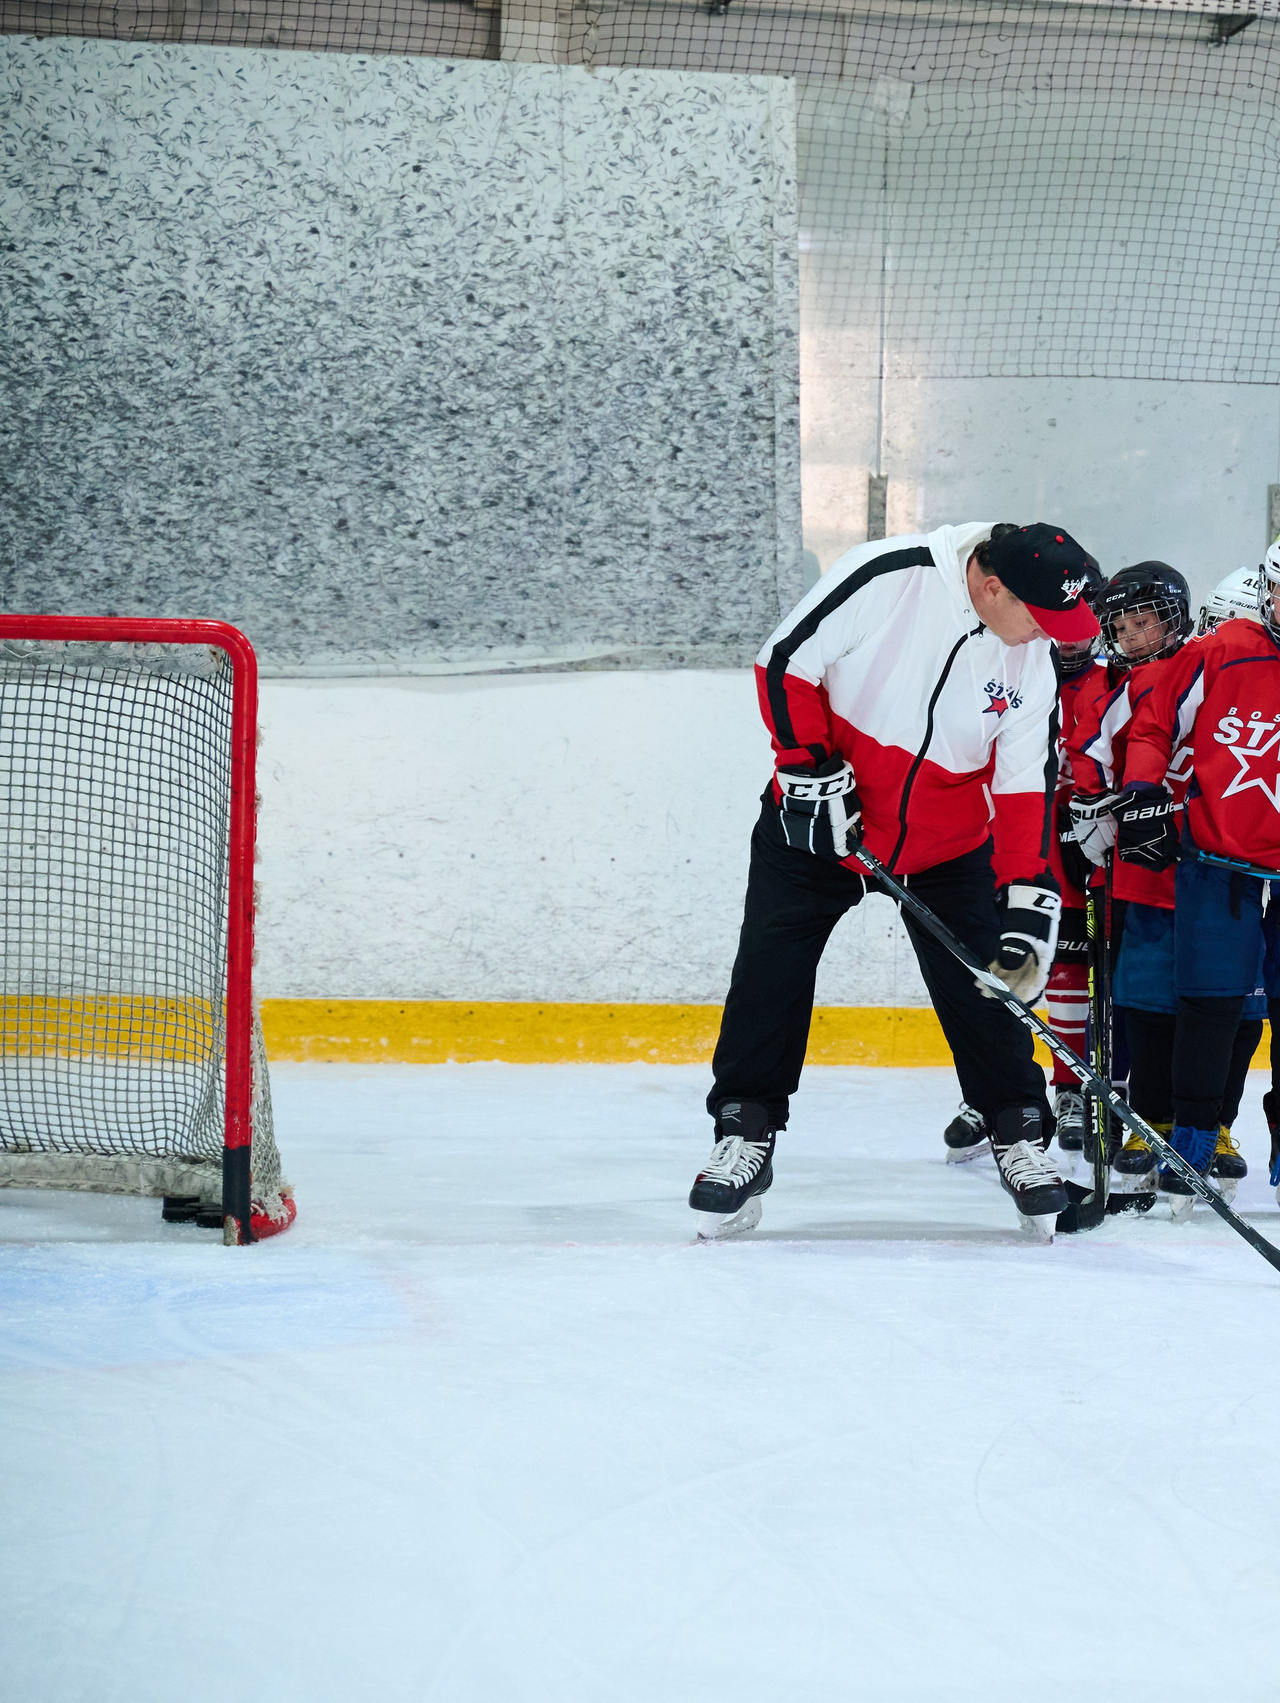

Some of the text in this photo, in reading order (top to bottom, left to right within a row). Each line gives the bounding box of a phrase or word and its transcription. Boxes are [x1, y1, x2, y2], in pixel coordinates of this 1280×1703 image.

[1229, 599, 1260, 611] BAUER
[983, 681, 1023, 709] STAS
[1071, 804, 1111, 821] AUE
[1122, 800, 1175, 822] BAUE
[1058, 940, 1088, 951] AUE
